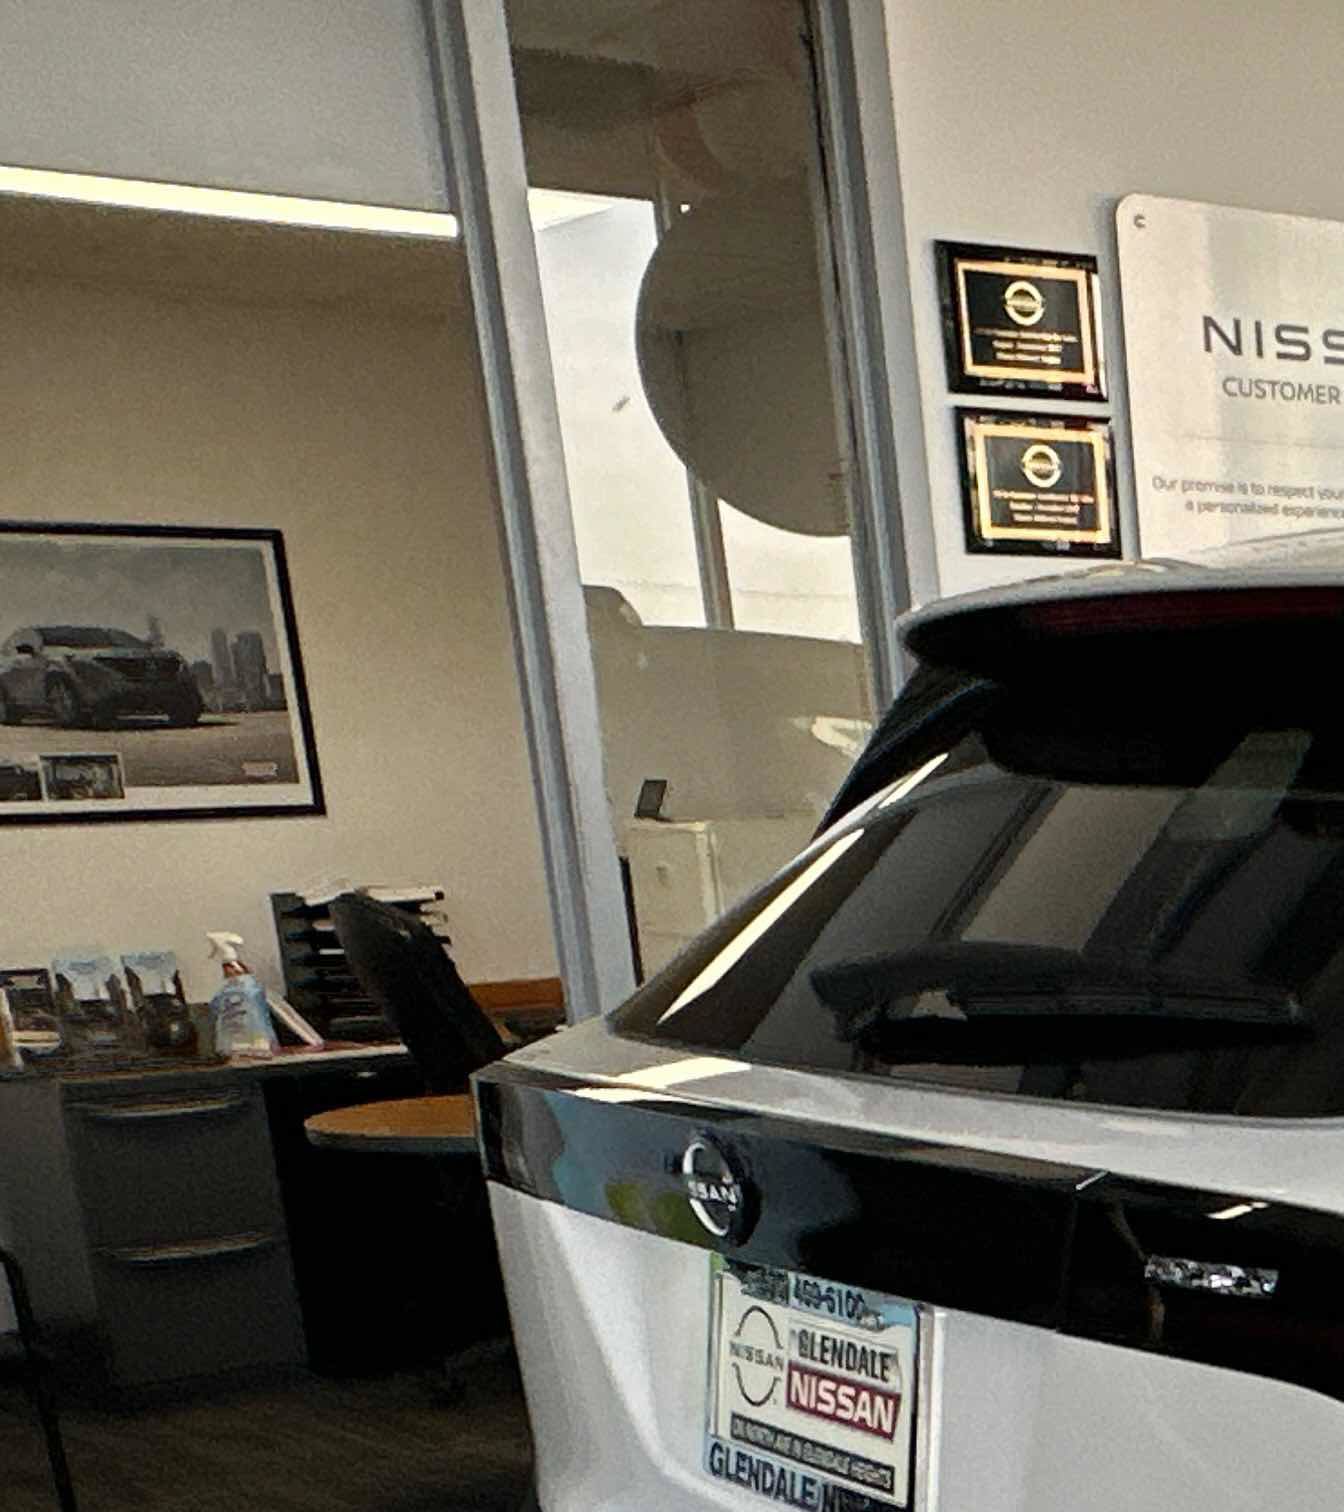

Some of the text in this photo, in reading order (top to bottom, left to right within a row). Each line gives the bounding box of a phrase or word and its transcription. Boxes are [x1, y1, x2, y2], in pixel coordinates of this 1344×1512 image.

[1221, 376, 1342, 406] CUSTOMER
[1151, 475, 1178, 491] Our
[1180, 479, 1234, 495] promise
[1237, 481, 1249, 495] is
[1250, 482, 1265, 496] to
[1267, 485, 1315, 501] respect
[1317, 487, 1344, 502] your
[1185, 500, 1195, 511] a
[1197, 501, 1279, 516] personalized
[729, 1340, 785, 1371] NISSAN
[797, 1328, 893, 1382] GLENDALE
[789, 1370, 895, 1433] NISSAN
[709, 1441, 816, 1508] GLENDALE
